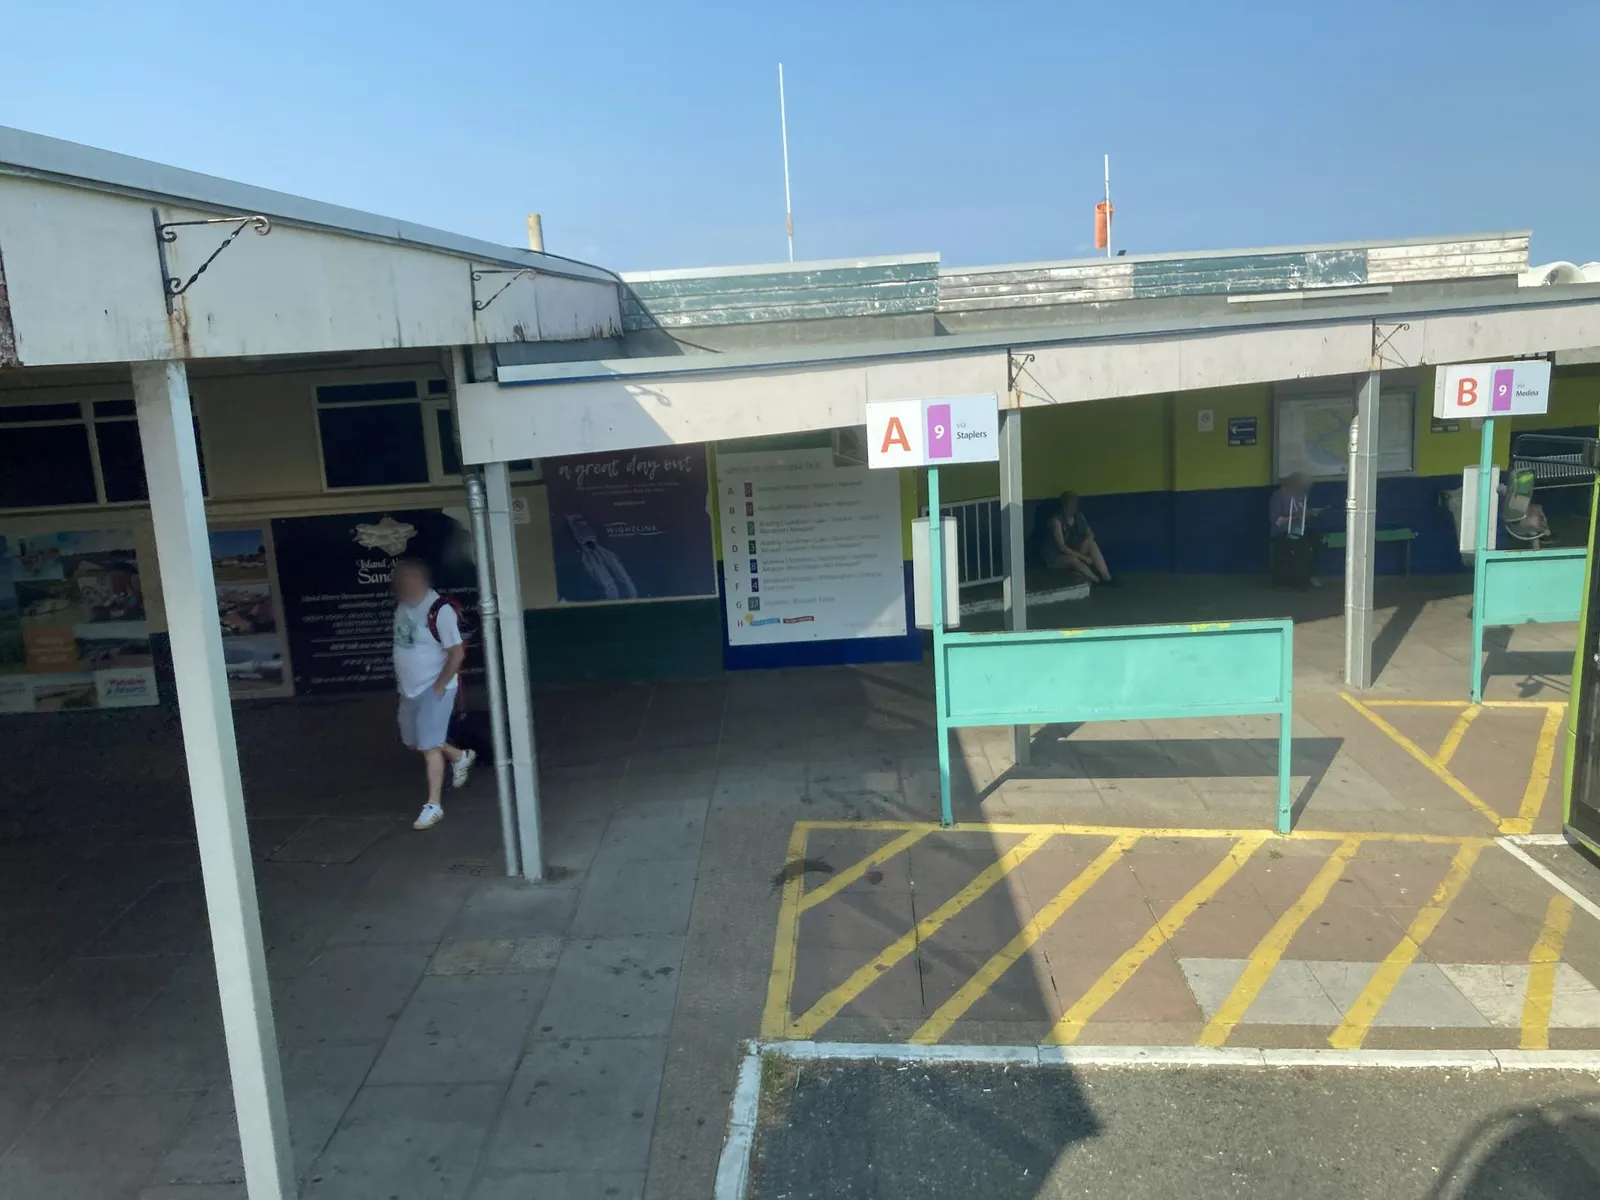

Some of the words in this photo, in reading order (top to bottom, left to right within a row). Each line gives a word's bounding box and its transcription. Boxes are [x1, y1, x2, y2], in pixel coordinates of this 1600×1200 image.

[1457, 377, 1478, 406] B
[1498, 384, 1508, 396] 9
[956, 421, 967, 429] via
[880, 416, 912, 453] A
[934, 424, 945, 439] 9
[956, 429, 988, 441] Staplers
[574, 458, 621, 486] great
[626, 454, 660, 480] day
[663, 456, 693, 473] out
[727, 487, 735, 496] A
[728, 506, 736, 515] B
[730, 525, 737, 534] C
[732, 544, 738, 553] D
[355, 558, 386, 569] Island
[733, 564, 740, 572] E
[735, 582, 741, 591] F
[736, 600, 742, 609] G
[737, 619, 744, 628] H
